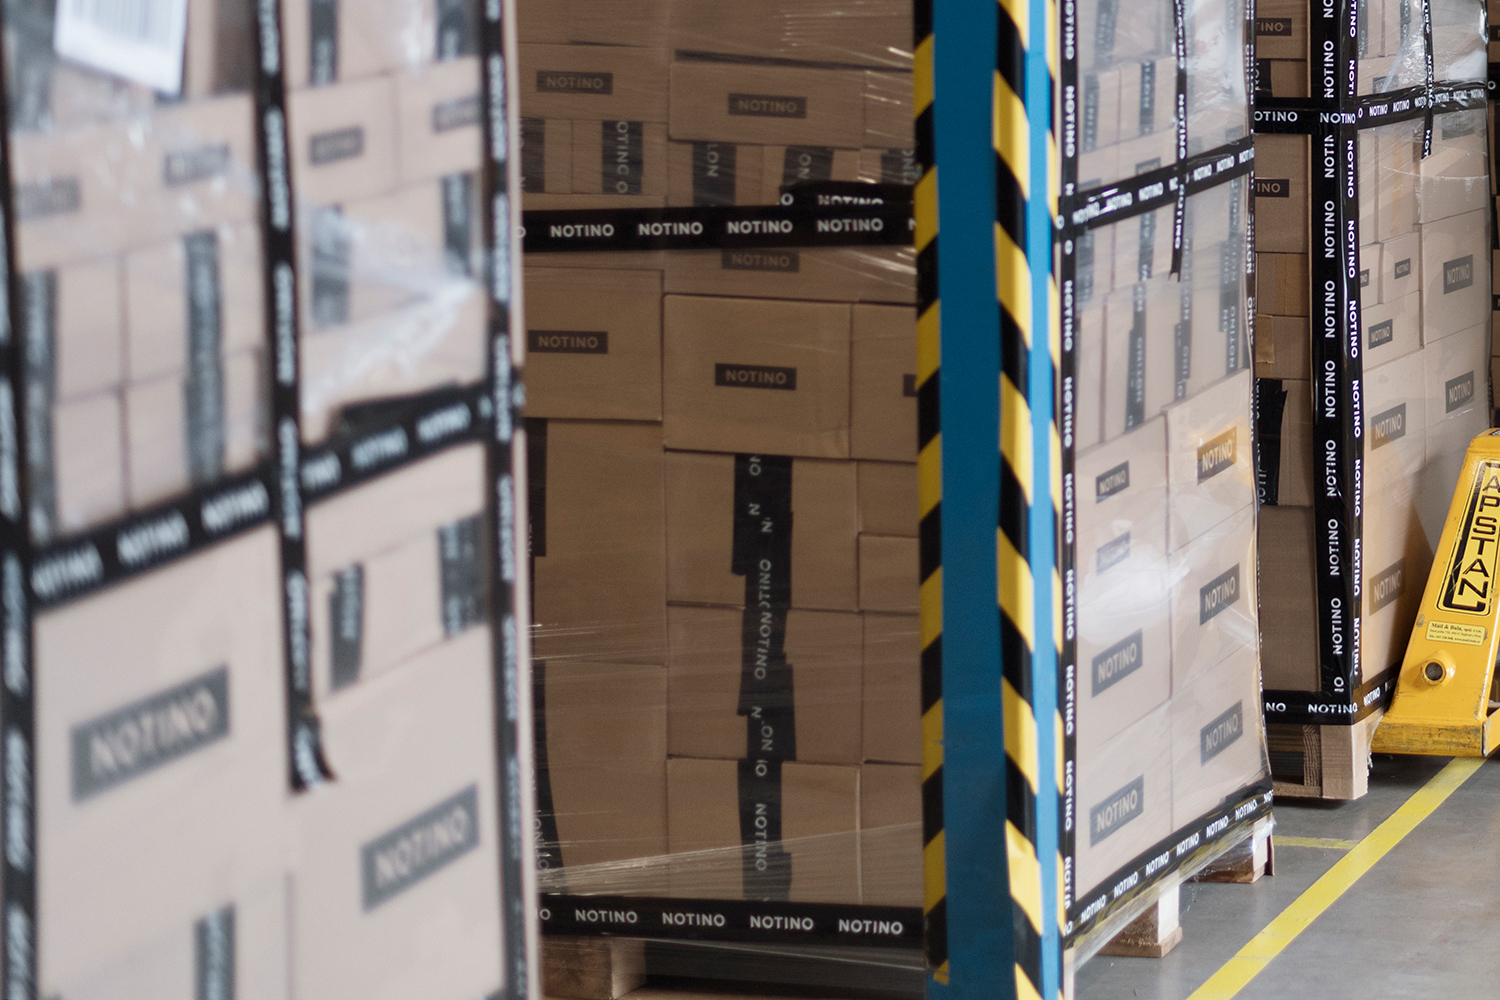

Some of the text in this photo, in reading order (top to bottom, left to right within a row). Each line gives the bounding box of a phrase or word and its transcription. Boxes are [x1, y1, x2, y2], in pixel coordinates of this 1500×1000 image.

[546, 76, 603, 90] NOTINO
[1323, 40, 1335, 98] NOTINO
[738, 99, 798, 115] NOTINO
[1320, 112, 1356, 124] NOTINO
[1347, 140, 1355, 198] NOTINO
[550, 217, 884, 239] NOTINO NOTINO NOTINO NOTINO
[731, 254, 790, 268] NOTINO
[1347, 220, 1356, 278] NOTINO
[538, 335, 599, 349] NOTINO
[1349, 300, 1358, 358] NOTINO
[725, 369, 787, 385] NOTINO
[1325, 200, 1342, 655] NOTINO NOTINO NOTINO NOTINO NOTINO NOTINO
[1352, 380, 1361, 438] NOTINO
[1375, 414, 1402, 441] NOTINO
[1202, 438, 1234, 472] NOTINO
[1205, 572, 1237, 613] NOTINO
[1098, 640, 1139, 684] NOTINO
[1307, 702, 1358, 714] NOTINO
[89, 684, 217, 778] NOTINO
[1206, 713, 1239, 753] NOTINO
[1097, 789, 1139, 834] NOTINO
[375, 807, 469, 885] NOTINO
[754, 803, 768, 872] NOTINO
[575, 909, 904, 935] NOTINO NOTINO NOTINO NOTINO
